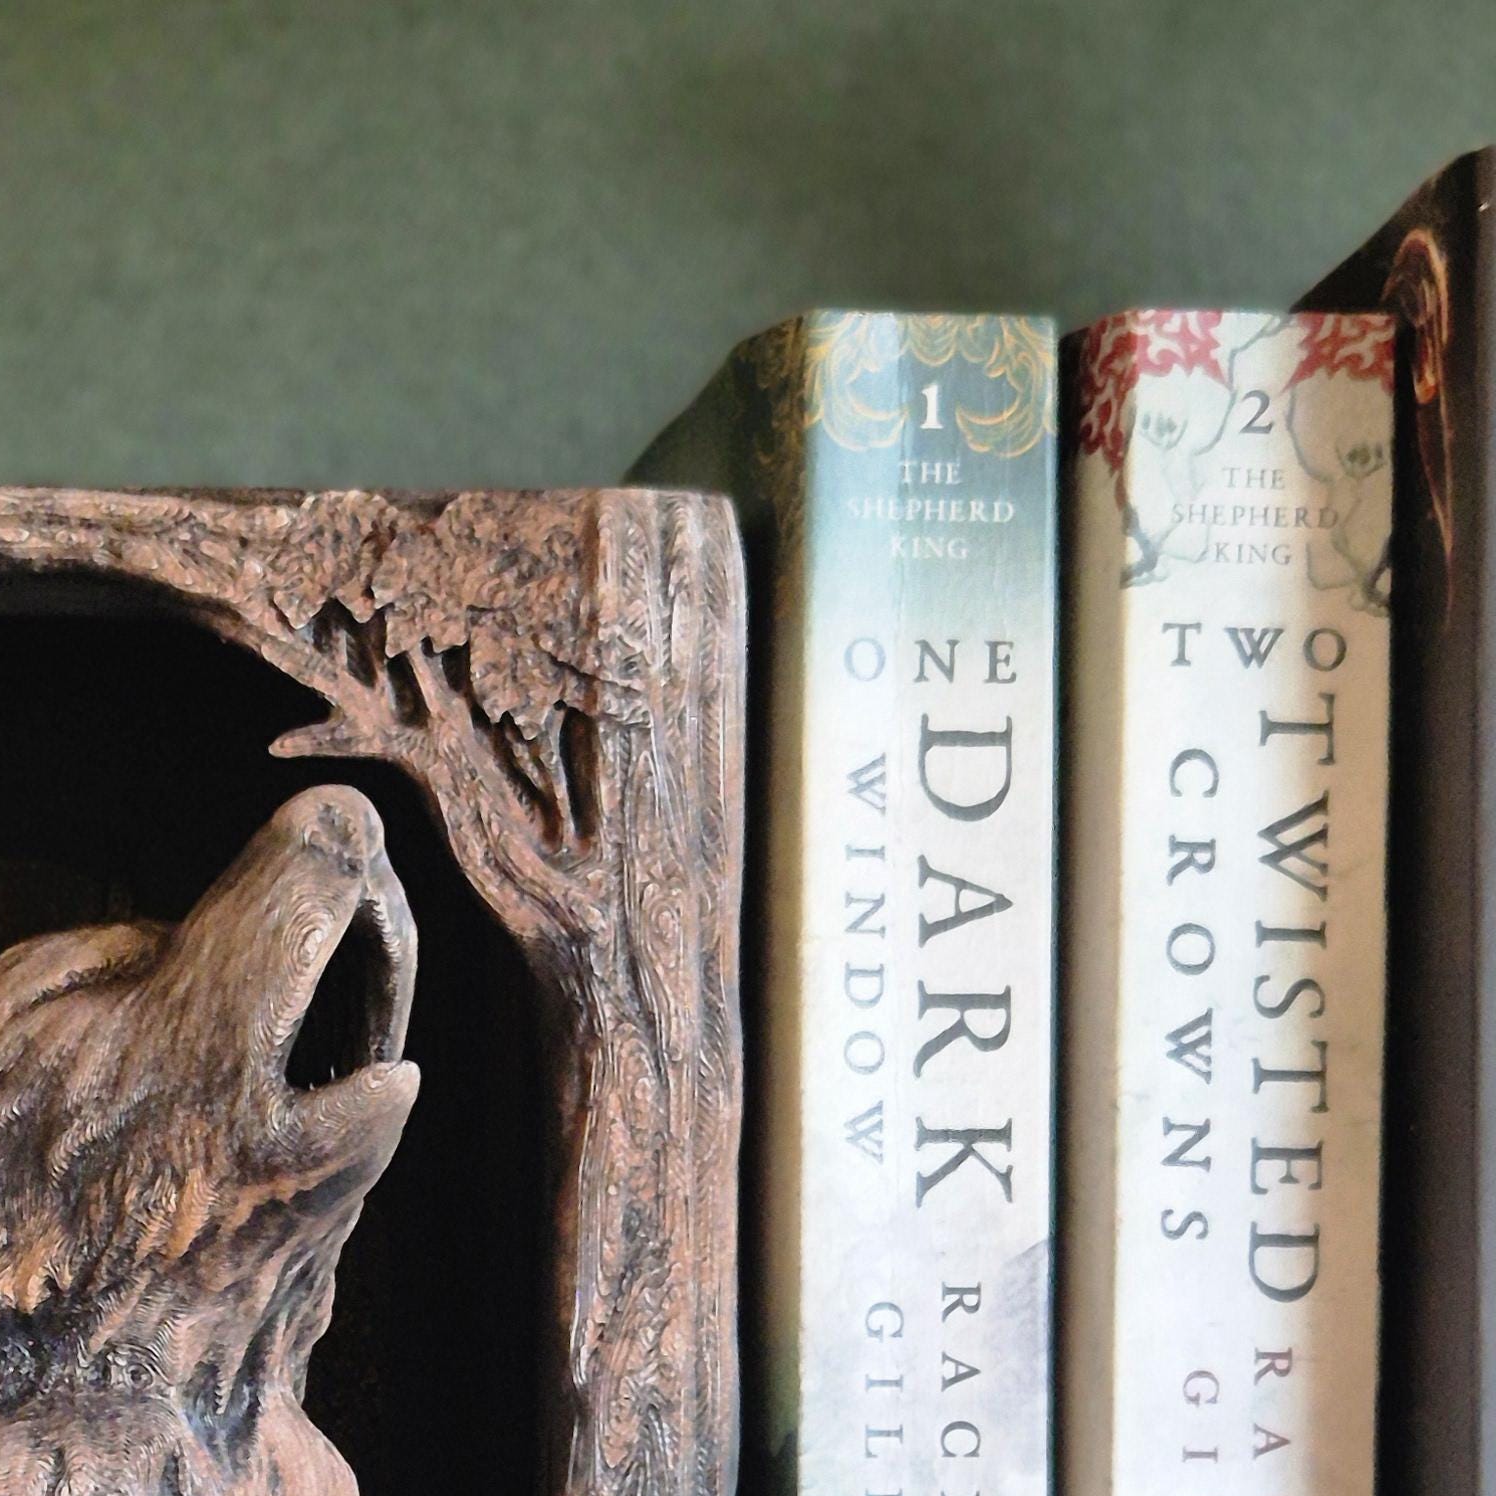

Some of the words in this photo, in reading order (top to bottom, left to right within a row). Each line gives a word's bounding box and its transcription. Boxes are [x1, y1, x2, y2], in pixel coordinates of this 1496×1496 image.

[918, 383, 944, 430] 1
[1239, 389, 1274, 435] 2
[899, 460, 964, 486] THE
[1221, 466, 1286, 491] THE
[847, 497, 1016, 524] SHEPHERD
[1170, 503, 1339, 530] SHEPHERD
[889, 536, 970, 561] KING
[1214, 541, 1292, 567] KING
[843, 636, 1018, 684] ONE
[1161, 622, 1348, 672] TWO
[841, 753, 887, 1165] WINDOW
[913, 713, 1014, 1208] DARK
[1160, 749, 1221, 1242] CROWNS
[1248, 693, 1336, 1304] TWISTED
